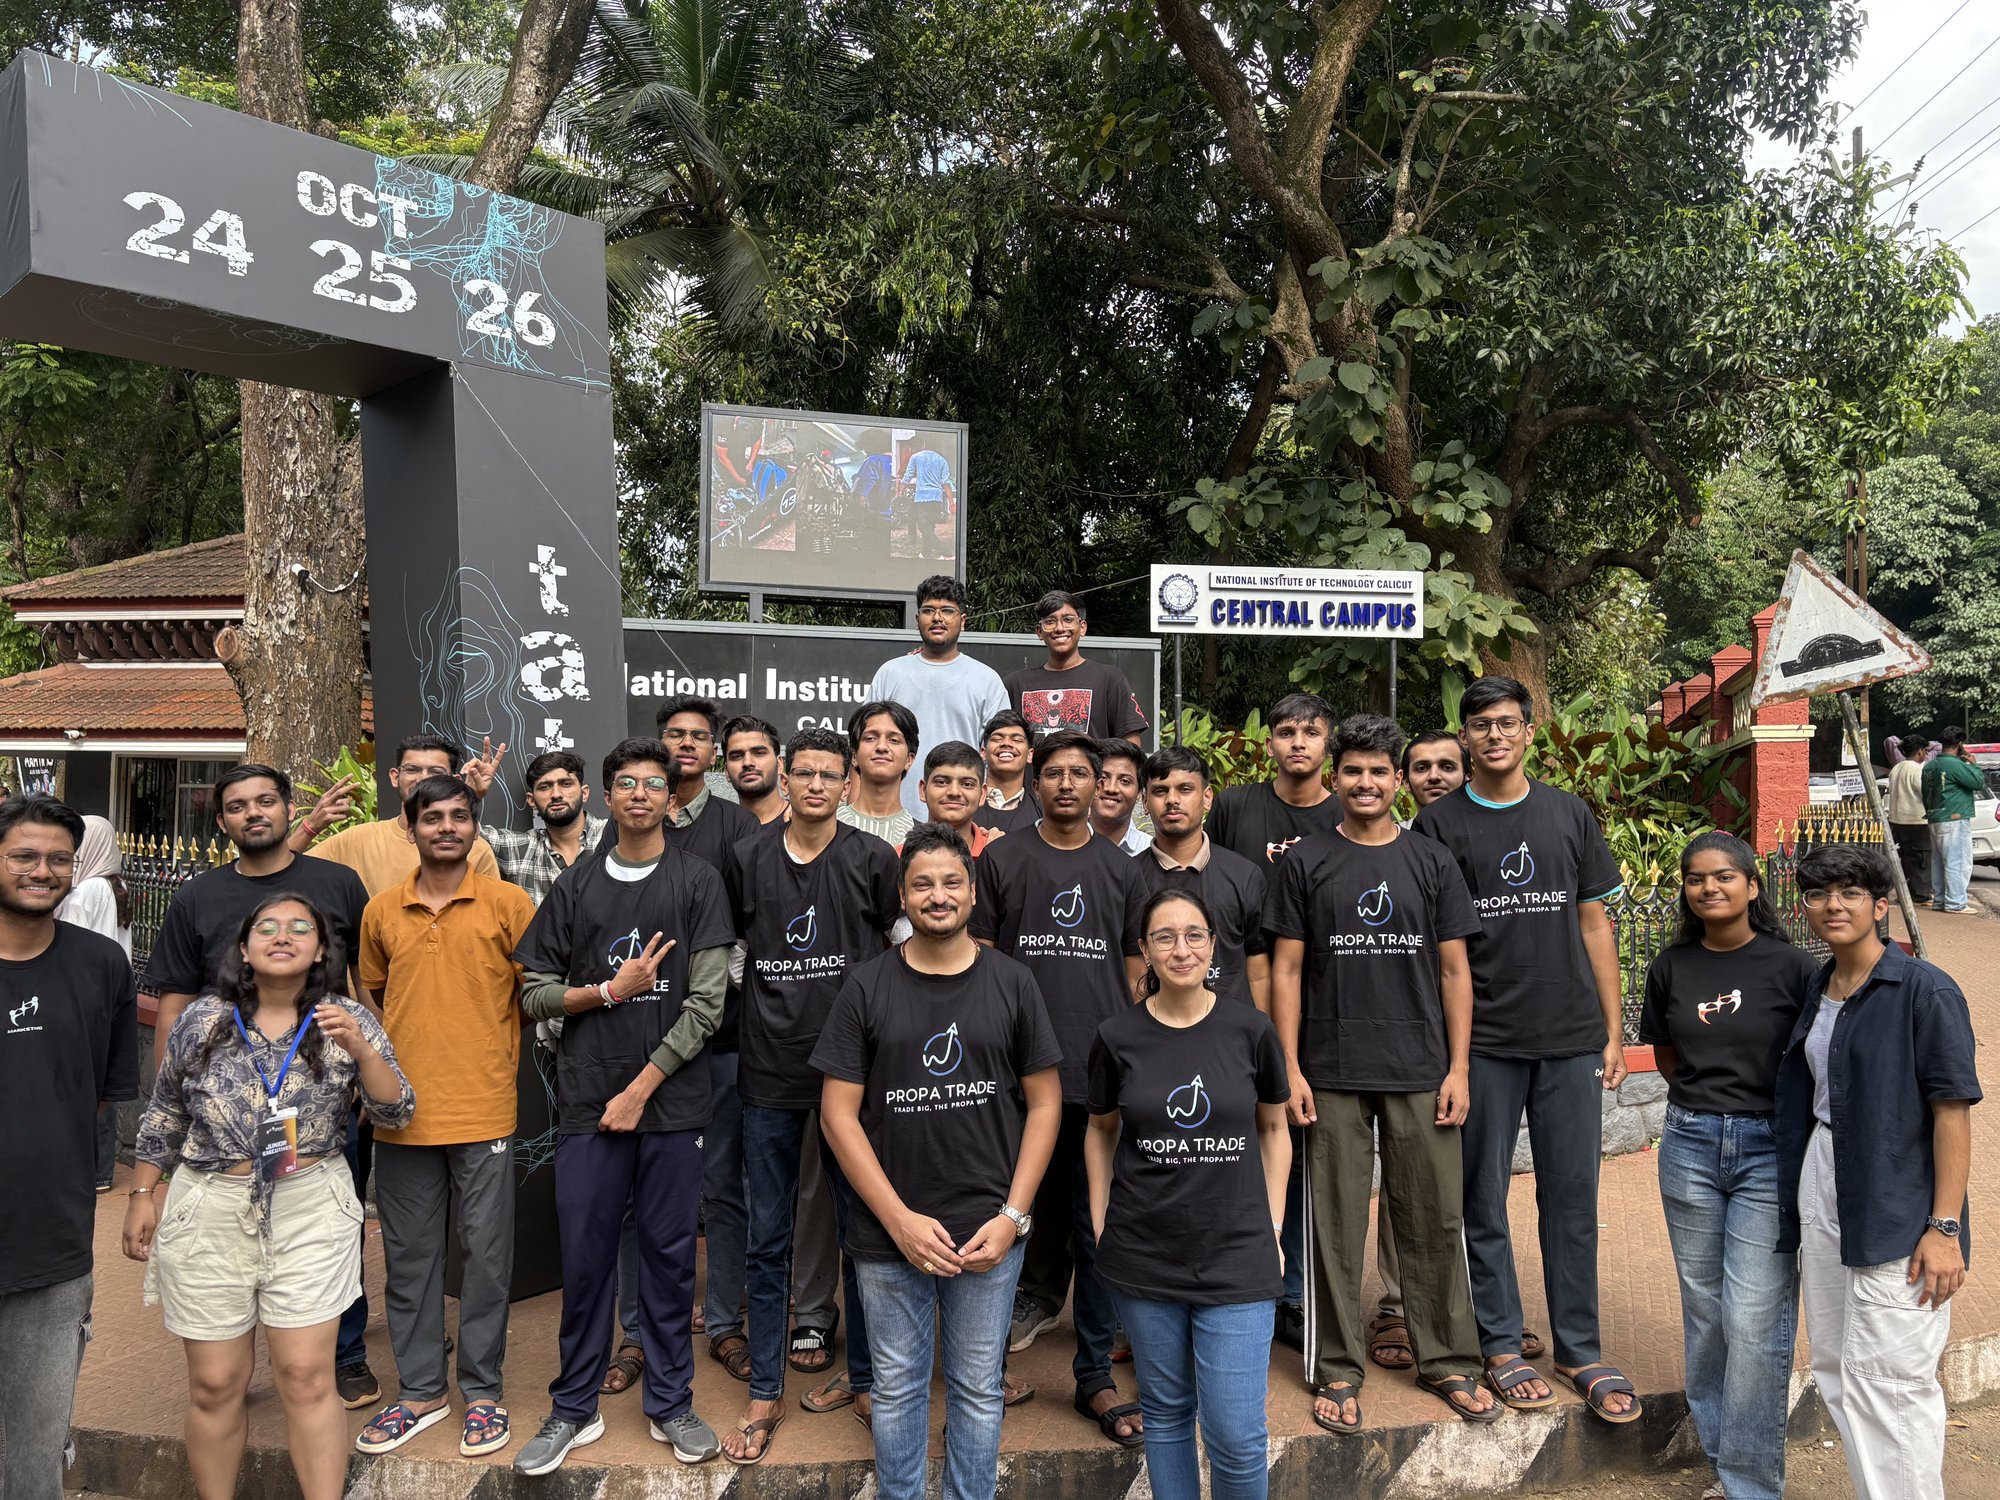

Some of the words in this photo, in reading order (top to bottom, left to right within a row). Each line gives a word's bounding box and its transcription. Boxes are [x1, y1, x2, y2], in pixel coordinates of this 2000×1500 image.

[297, 170, 418, 238] OCT
[122, 191, 254, 276] 24
[309, 239, 417, 313] 25
[464, 279, 557, 347] 26
[1215, 575, 1258, 586] NATIONAL
[1260, 576, 1303, 588] INSTITUTE
[1306, 578, 1317, 587] OF
[1320, 579, 1374, 589] TECHNOLOGY
[1377, 580, 1413, 590] CALICUT
[1211, 598, 1314, 625] CENTRAL
[1320, 601, 1417, 628] CAMPUS
[766, 668, 872, 702] Institu
[1523, 891, 1568, 904] TRADE
[1019, 934, 1066, 947] PROPA
[1329, 933, 1376, 946] PROPA
[1378, 933, 1424, 946] TRADE
[755, 960, 802, 973] PROPA
[804, 955, 846, 970] TRADE
[886, 1086, 941, 1104] PROPA
[945, 1081, 996, 1098] TRADE
[266, 1140, 287, 1150] JUNIOR
[1136, 1138, 1190, 1153] PROPA
[1193, 1136, 1246, 1152] TRADE
[1147, 1155, 1162, 1164] TRADE
[1165, 1157, 1181, 1165] BIG,
[1183, 1156, 1197, 1164] THE
[792, 1338, 820, 1350] PUMA
